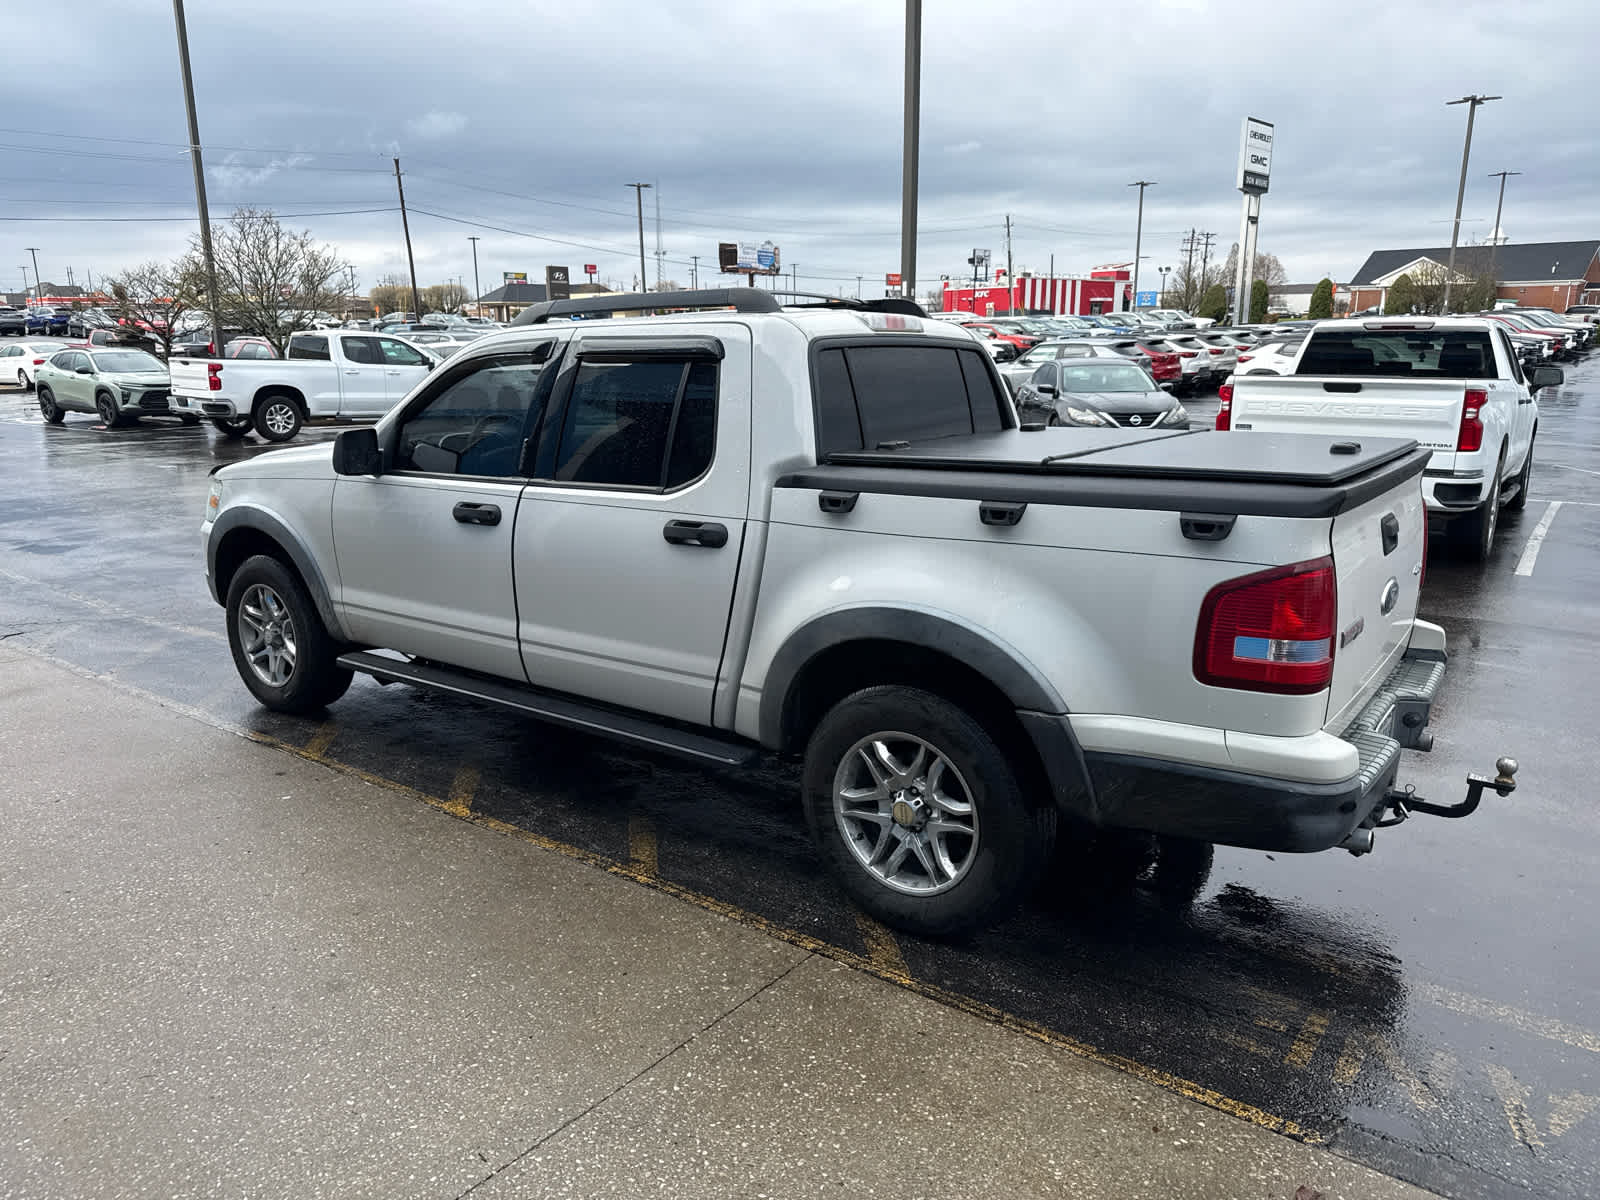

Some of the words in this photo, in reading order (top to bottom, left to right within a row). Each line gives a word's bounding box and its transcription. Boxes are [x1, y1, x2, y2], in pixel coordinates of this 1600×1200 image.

[1250, 130, 1271, 143] CHEVROLET
[1251, 154, 1267, 166] GMC
[974, 290, 990, 298] KFC
[1247, 400, 1447, 420] CHEVROLET
